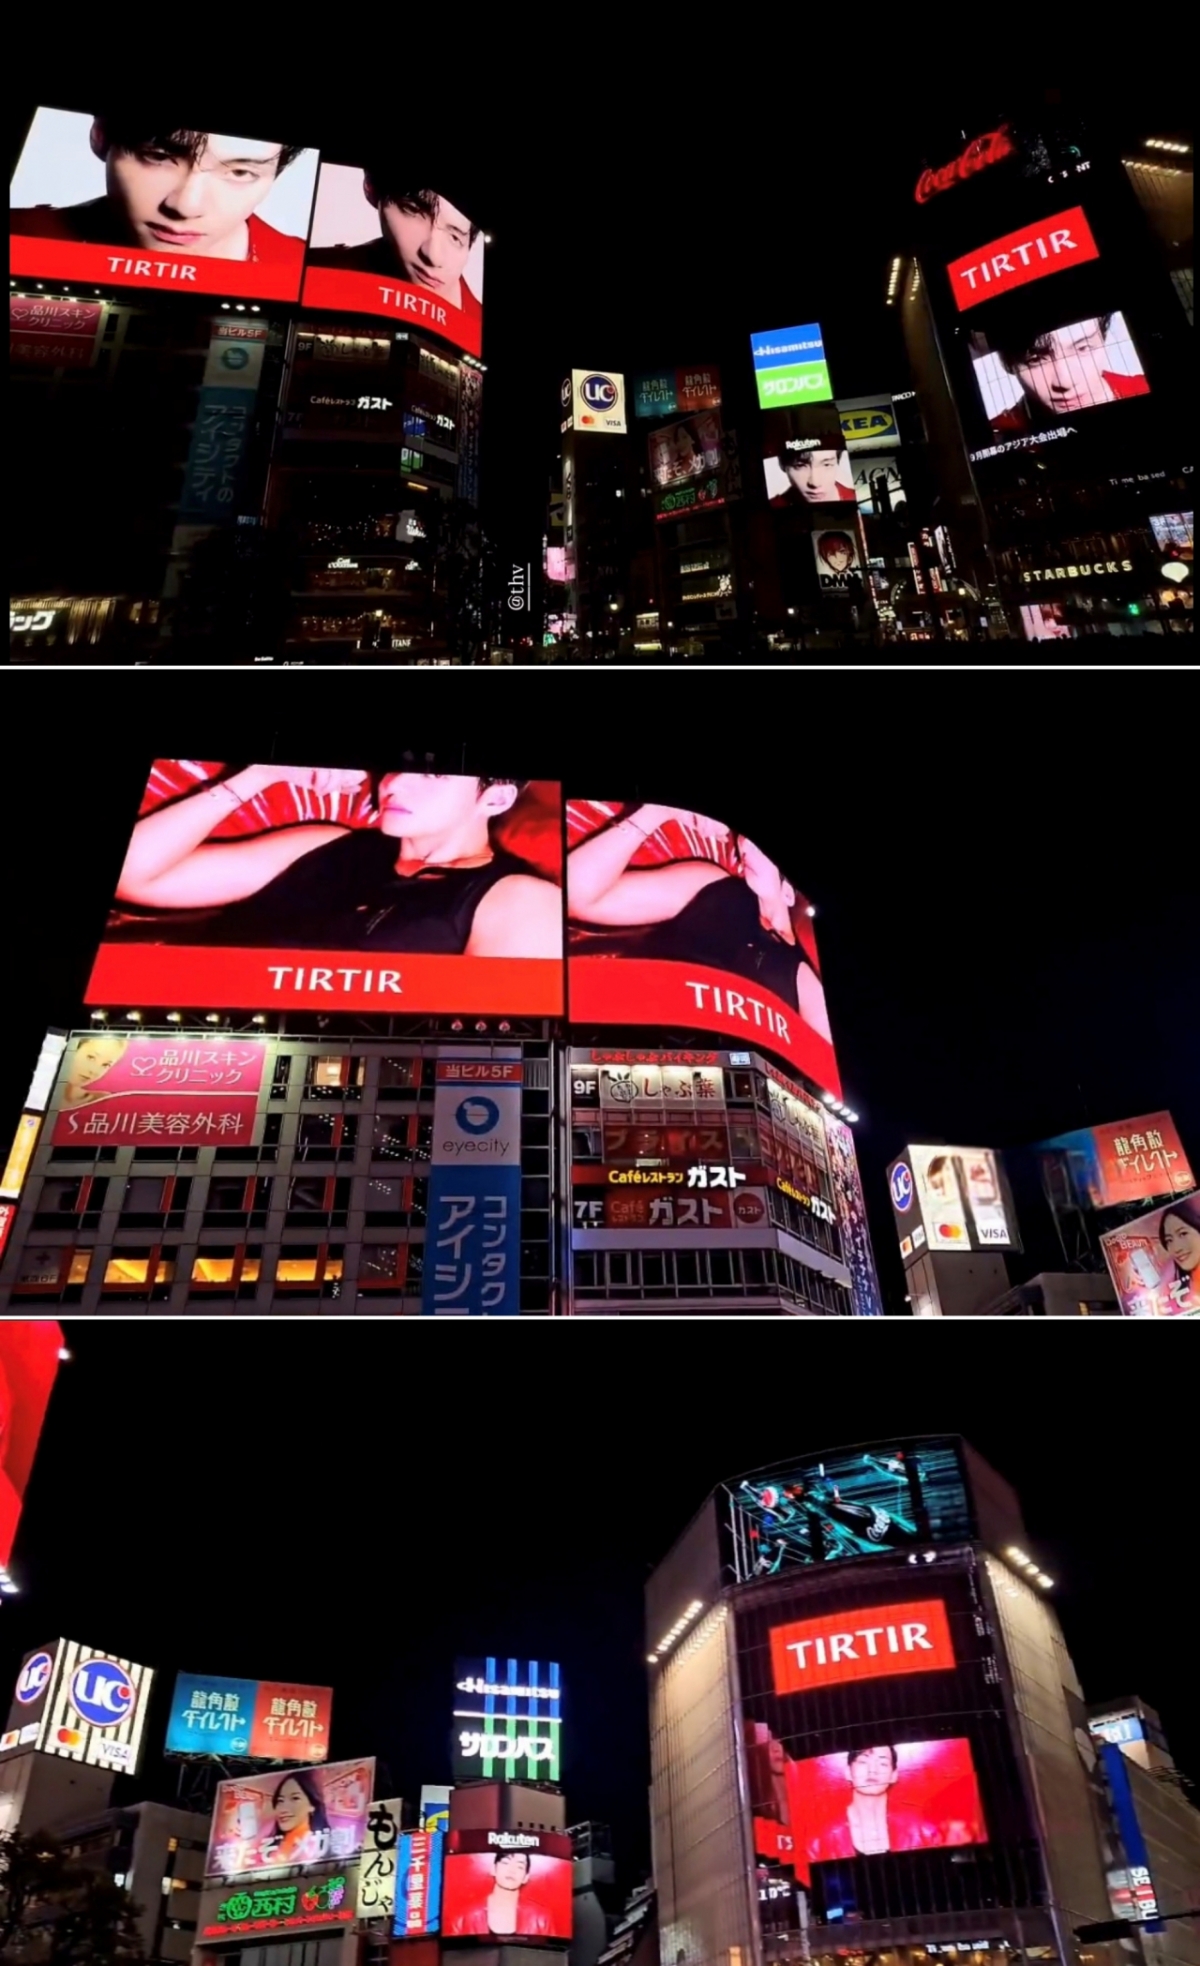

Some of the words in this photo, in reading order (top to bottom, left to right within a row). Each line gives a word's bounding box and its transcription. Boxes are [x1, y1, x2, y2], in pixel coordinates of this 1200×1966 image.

[107, 256, 196, 281] TIRTIR
[960, 229, 1078, 289] TIRTIR
[30, 304, 96, 320] 品川スキン
[378, 286, 447, 326] TIRTIR
[28, 317, 86, 330] クリニック
[218, 325, 261, 338] 当ビル5F
[762, 339, 823, 356] Hisamitsu
[357, 396, 393, 410] ガスト
[585, 383, 615, 402] UC
[605, 418, 621, 427] VISA
[841, 414, 888, 431] KEA
[786, 439, 821, 450] Rakuten
[1023, 560, 1133, 582] STARBUCKS
[267, 966, 402, 995] TIRTIR
[685, 981, 791, 1044] TIRTIR
[159, 1049, 258, 1066] 品川スキン
[591, 1050, 719, 1064] しゃぶしゃぶバイキング
[156, 1068, 243, 1084] クリニック
[446, 1065, 513, 1078] 当ビル5F
[573, 1080, 596, 1095] 9F
[643, 1078, 716, 1098] しゃぶ葉
[83, 1112, 244, 1135] 品川美容外科
[443, 1138, 510, 1157] eyecity
[1113, 1129, 1164, 1157] 龍角散
[687, 1165, 746, 1188] ガスト
[892, 1170, 911, 1203] UC
[574, 1201, 603, 1219] 7F
[650, 1196, 723, 1226] ガスト
[738, 1205, 761, 1215] ガスト
[811, 1195, 836, 1226] ガスト
[980, 1228, 1008, 1239] VISA
[434, 1196, 476, 1314] アイシ
[481, 1196, 507, 1315] コンタク
[786, 1623, 933, 1670] TIRTIR
[20, 1662, 48, 1692] UC
[74, 1670, 129, 1713] UC
[466, 1677, 560, 1699] Hisamitsu
[102, 1743, 128, 1759] VISA
[459, 1731, 555, 1761] サロンパス
[488, 1832, 540, 1849] Rakuten
[362, 1803, 399, 1912] もんじゃ
[1131, 1867, 1159, 1920] SEIBU
